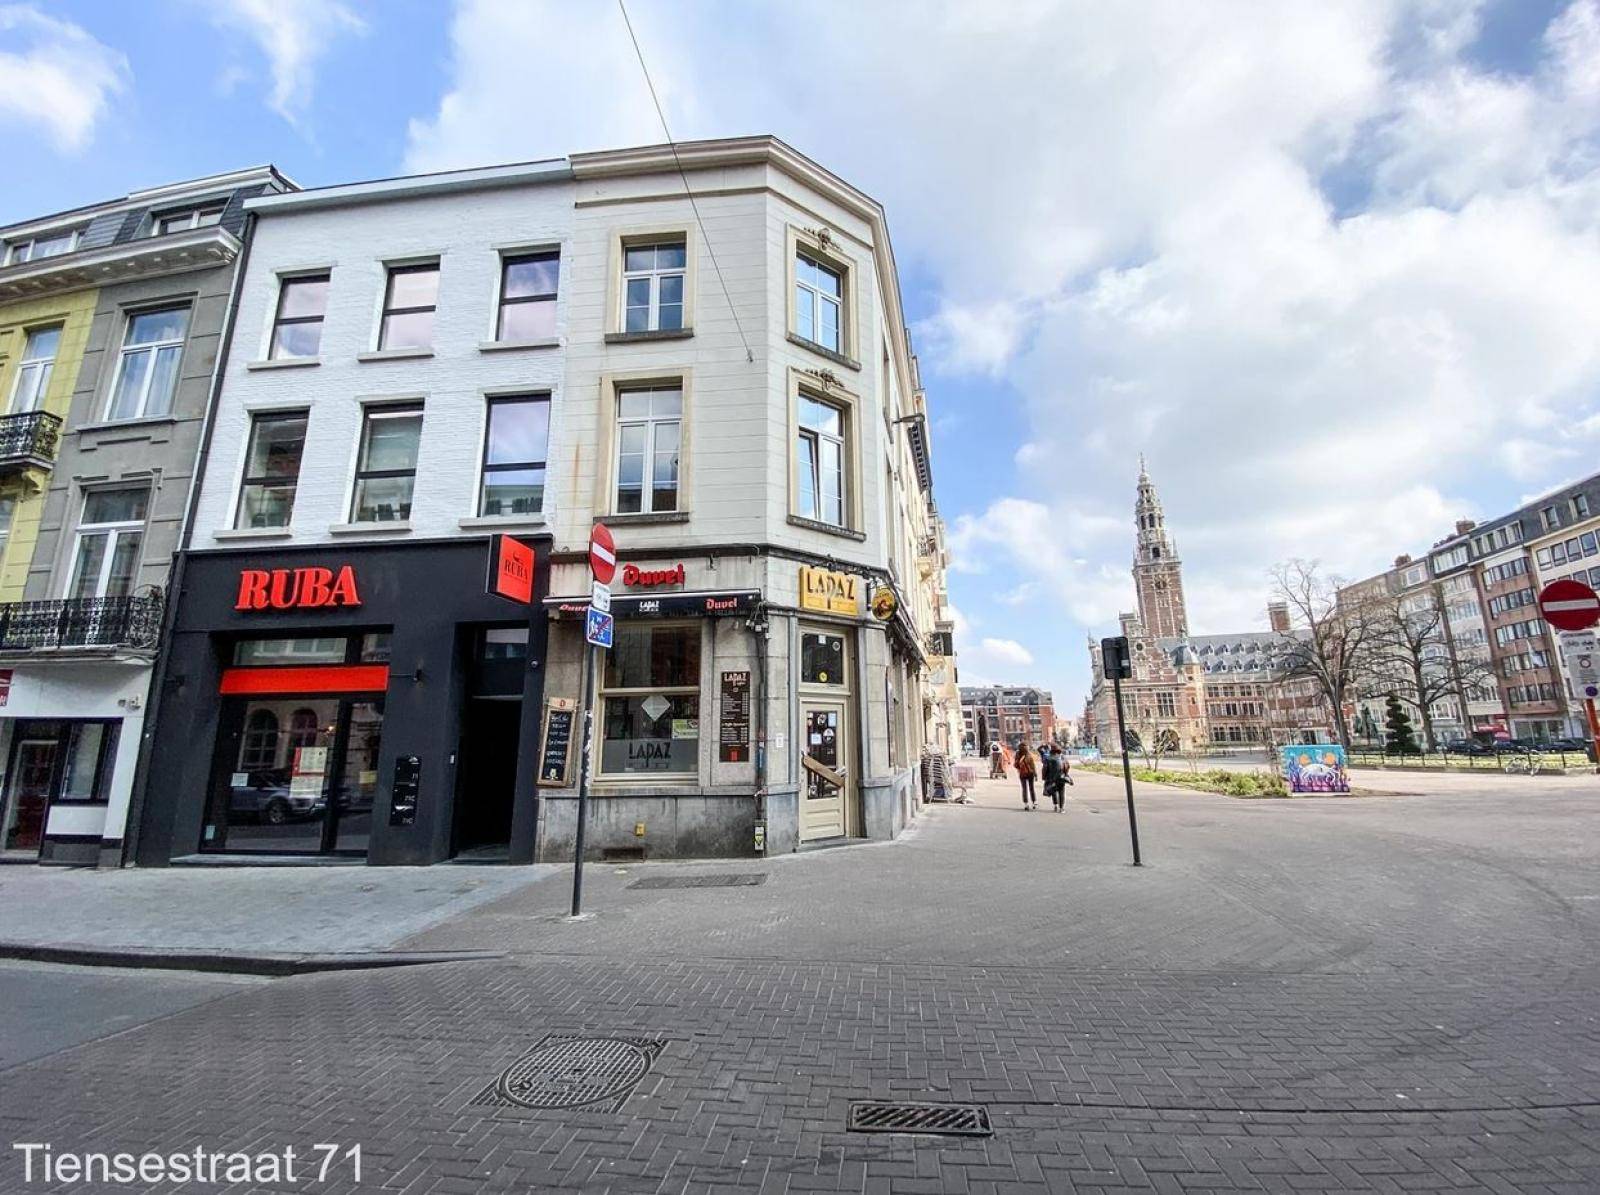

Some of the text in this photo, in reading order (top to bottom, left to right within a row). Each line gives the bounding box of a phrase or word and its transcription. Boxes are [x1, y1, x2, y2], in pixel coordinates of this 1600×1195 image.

[504, 559, 529, 580] RUBA
[624, 564, 684, 586] Duvel
[235, 565, 361, 609] RUBA
[706, 598, 738, 611] Duvel
[629, 742, 671, 768] LAPAZ
